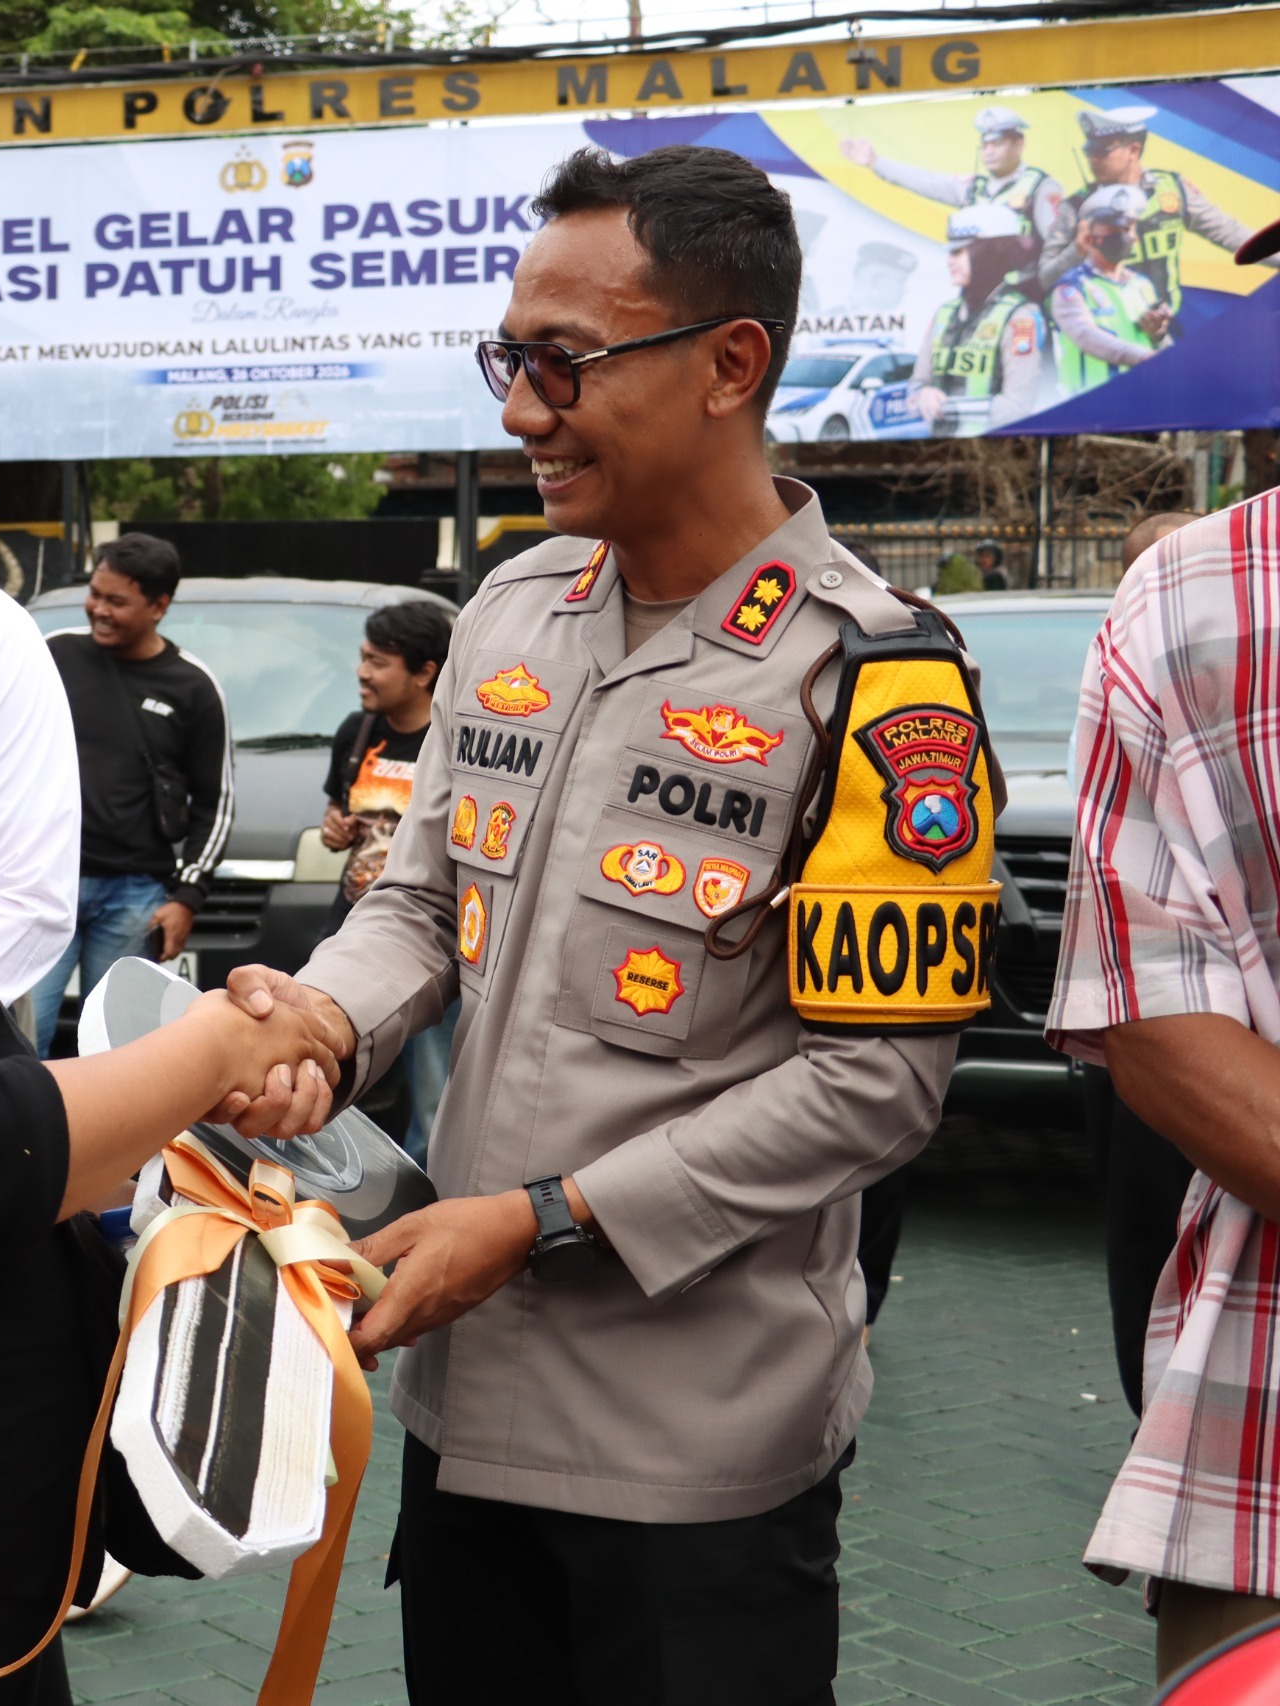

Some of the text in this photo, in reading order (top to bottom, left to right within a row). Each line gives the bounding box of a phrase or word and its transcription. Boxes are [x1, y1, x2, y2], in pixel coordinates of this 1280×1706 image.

[122, 71, 481, 129] POLRES
[556, 40, 981, 105] MALANG
[94, 206, 295, 251] GELAR
[322, 195, 546, 241] PASUK
[84, 255, 282, 299] PATUH
[309, 245, 521, 290] SEMER
[38, 340, 203, 360] MEWUJUDKAN
[211, 335, 349, 355] LALULINTAS
[358, 331, 422, 349] YANG
[796, 313, 905, 334] AMATAN
[456, 725, 543, 777] RULIAN
[689, 738, 713, 757] SELAM
[883, 718, 969, 741] POLRES
[891, 729, 963, 747] MALANG
[898, 751, 961, 770] JAWA TIMUR
[627, 764, 767, 838] POLRI
[637, 849, 659, 861] SAR
[796, 899, 1003, 998] KAOPSR
[626, 971, 670, 992] RESERSE
